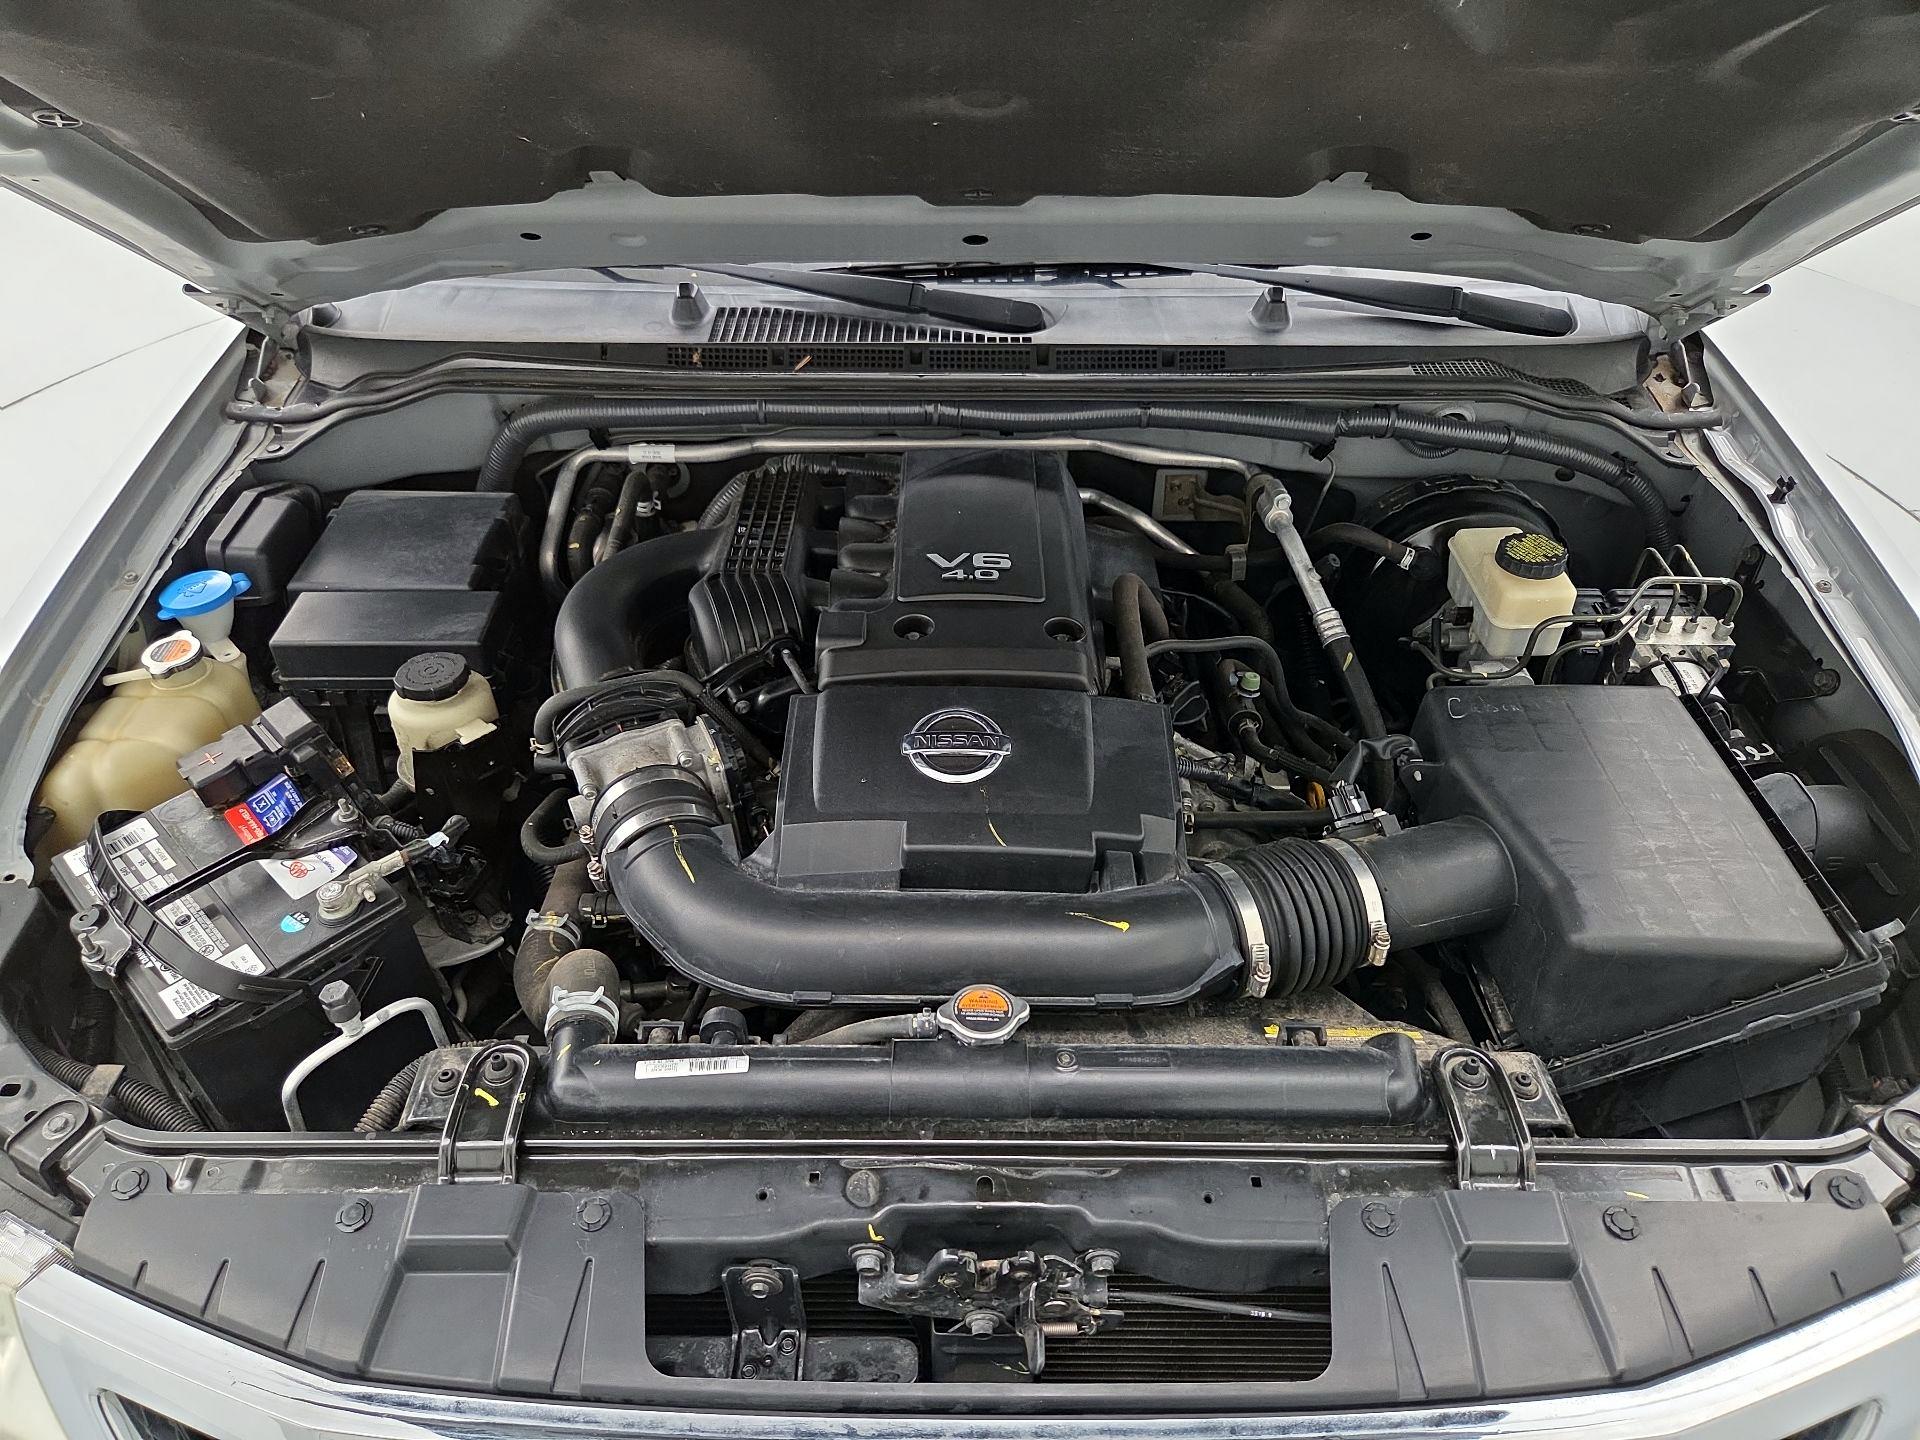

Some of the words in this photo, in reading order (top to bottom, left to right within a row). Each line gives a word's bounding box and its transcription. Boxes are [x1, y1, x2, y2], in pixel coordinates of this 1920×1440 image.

[926, 552, 1011, 568] V6
[941, 569, 999, 580] 4.0
[913, 735, 1000, 749] NISSAN
